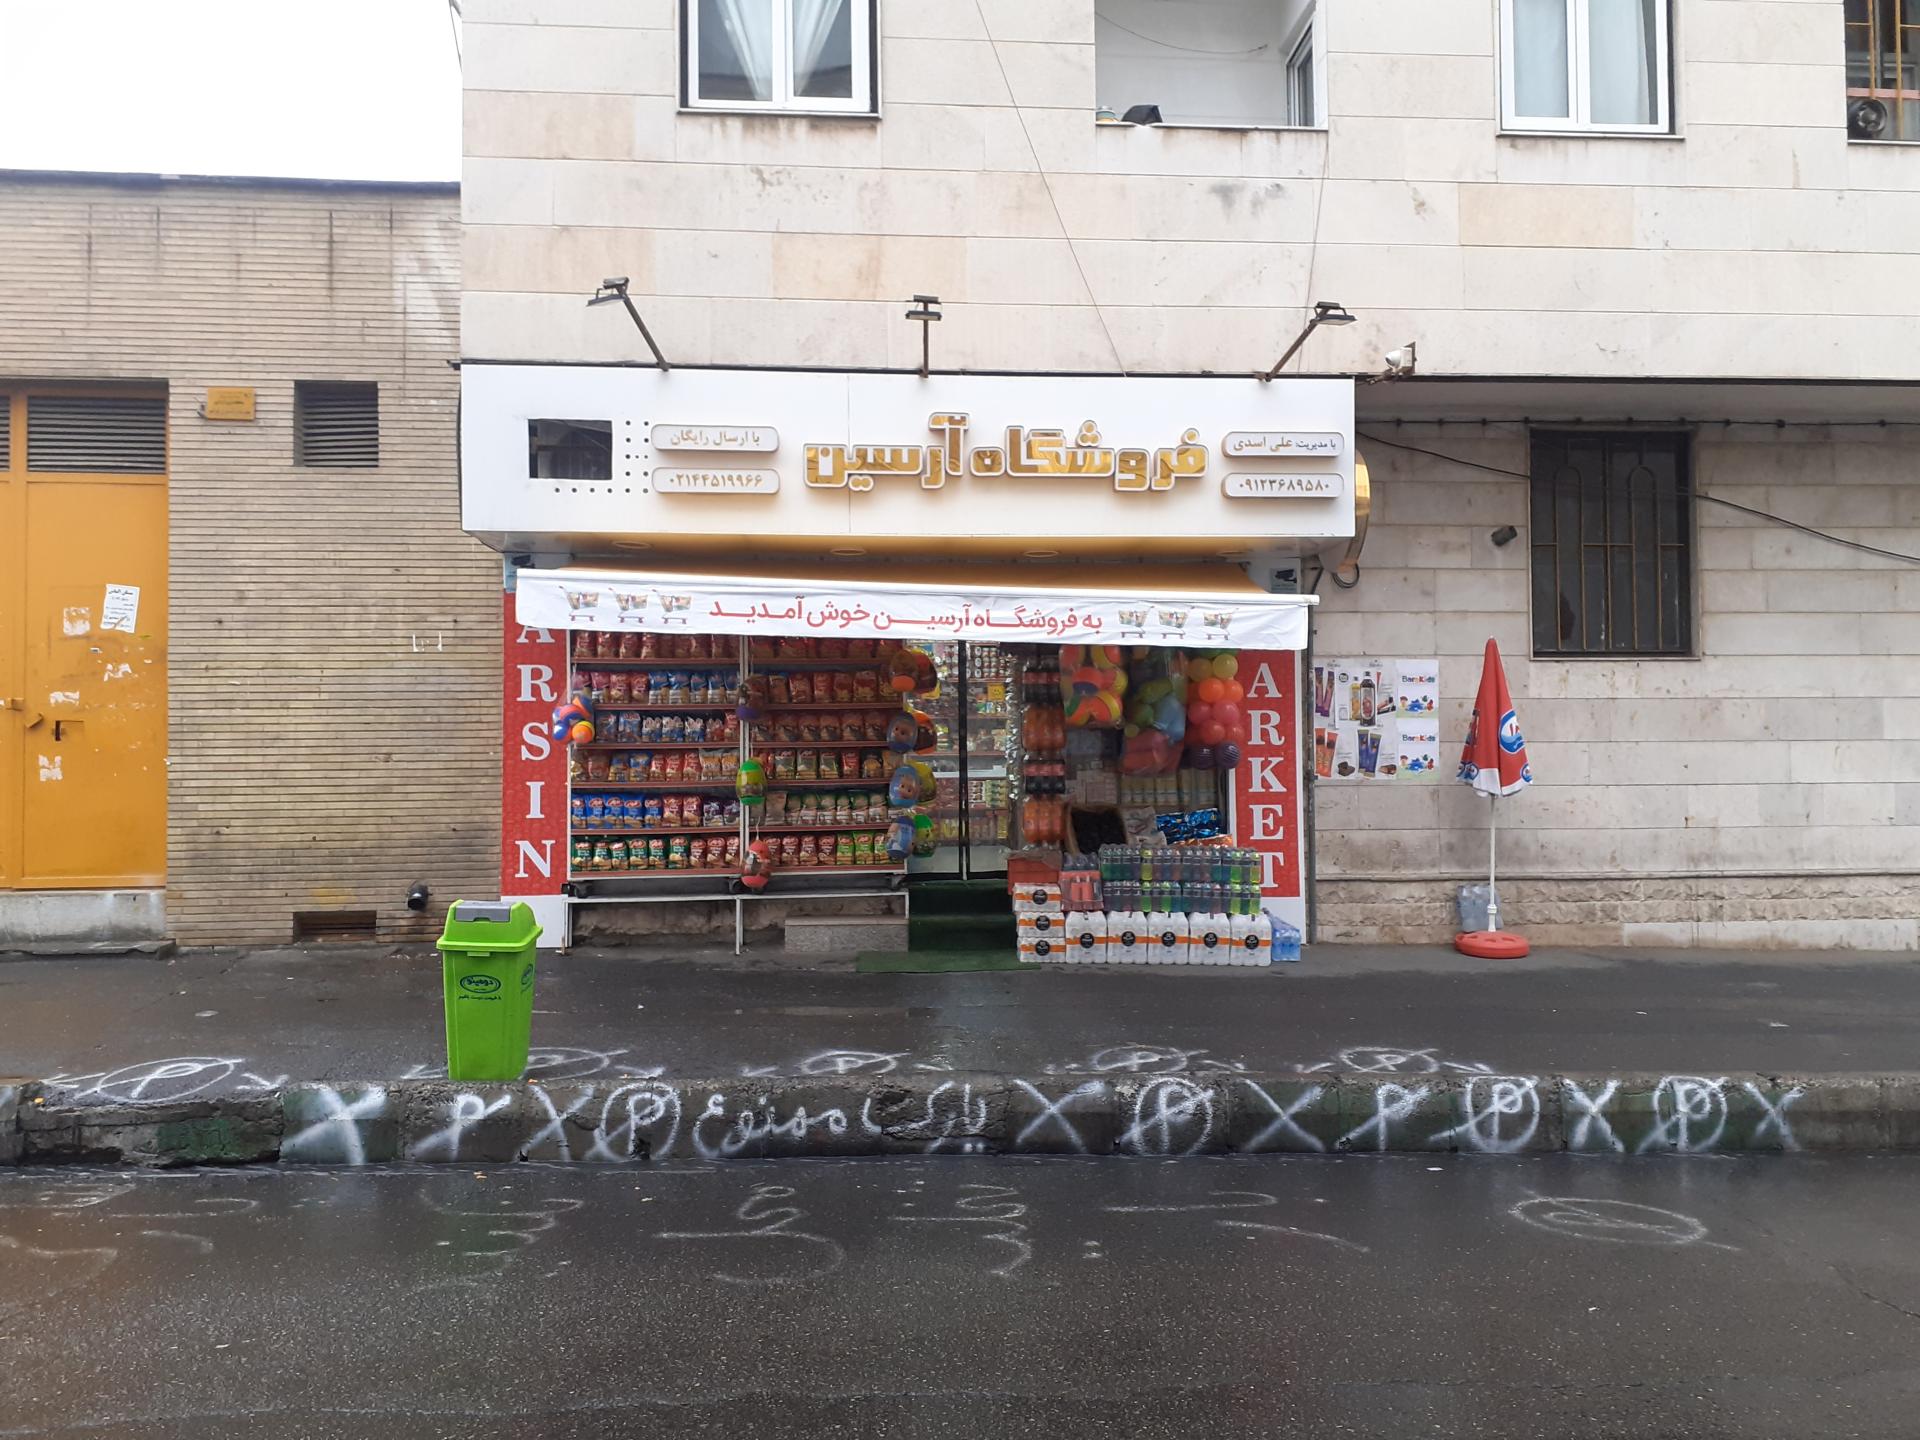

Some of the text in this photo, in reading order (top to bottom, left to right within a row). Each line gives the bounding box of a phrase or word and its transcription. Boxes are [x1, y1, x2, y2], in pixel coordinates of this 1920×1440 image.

[670, 429, 761, 447] با ارسال رایگان
[1233, 436, 1267, 451] اسدی
[1269, 436, 1293, 452] علی
[1329, 438, 1337, 451] با
[802, 411, 1210, 492] فروشگاه آرسین
[1239, 478, 1330, 492] ۰۹۱۲۳۶۸۹۵۸۰
[708, 595, 1104, 636] به فروشگاه آرسین خوش آمدید
